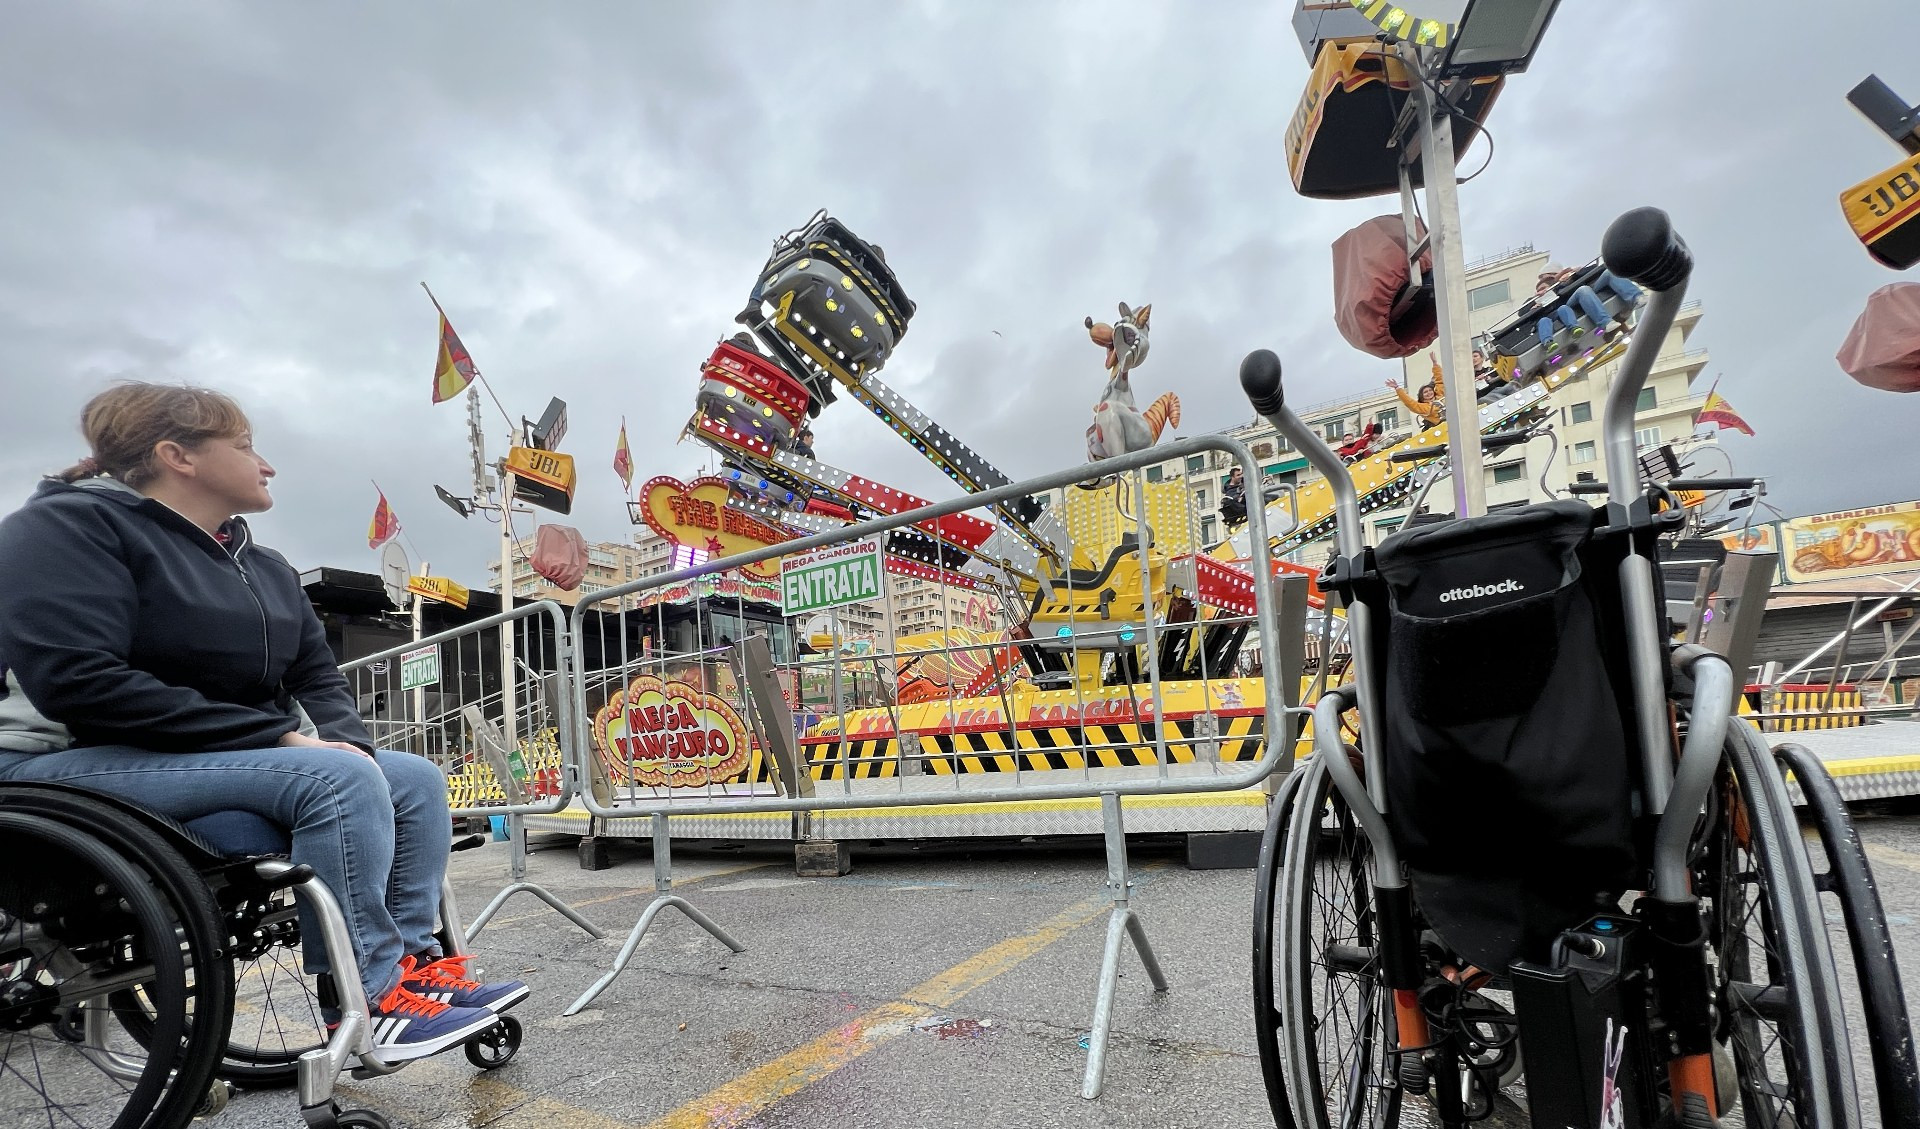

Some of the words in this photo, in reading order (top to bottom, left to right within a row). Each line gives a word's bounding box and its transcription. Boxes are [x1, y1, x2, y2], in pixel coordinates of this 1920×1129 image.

[530, 453, 562, 478] JBL
[1811, 506, 1897, 523] BIRRERIA
[782, 556, 816, 574] MEGA
[817, 541, 877, 561] CANGURO
[786, 559, 876, 610] ENTRATA
[1439, 579, 1524, 603] ottobock.
[403, 656, 437, 687] ENTRATA
[627, 702, 699, 735] MEGA
[1030, 697, 1158, 721] KANGURO
